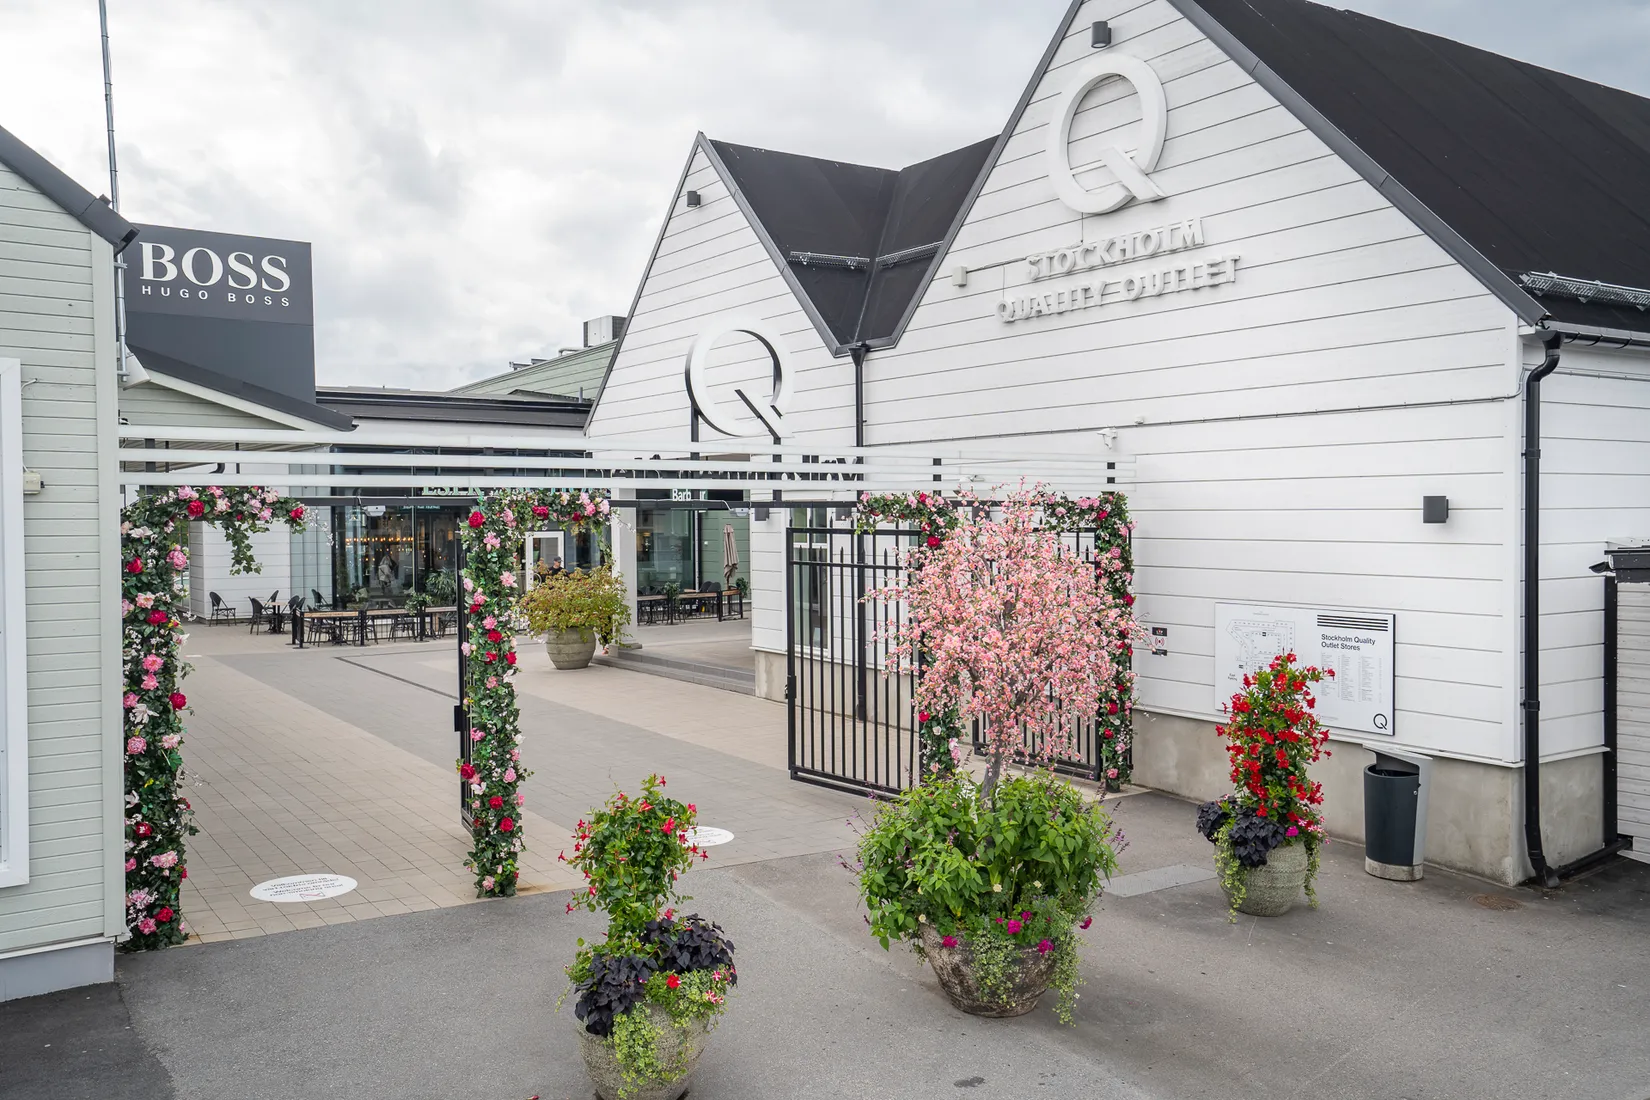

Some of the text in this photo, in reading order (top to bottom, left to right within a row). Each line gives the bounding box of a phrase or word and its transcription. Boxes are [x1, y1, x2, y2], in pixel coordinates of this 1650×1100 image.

[1047, 52, 1168, 214] Q
[139, 241, 291, 292] BOSS
[1028, 217, 1205, 280] STOCKHOLM
[142, 285, 289, 307] HUGO BOSS
[995, 255, 1241, 323] QUALITY OUTLET
[685, 314, 795, 438] Q
[672, 488, 706, 501] Barbr
[1321, 633, 1376, 646] Stockholm Quality
[1321, 641, 1361, 651] Outlet Stores
[1373, 713, 1388, 731] Q
